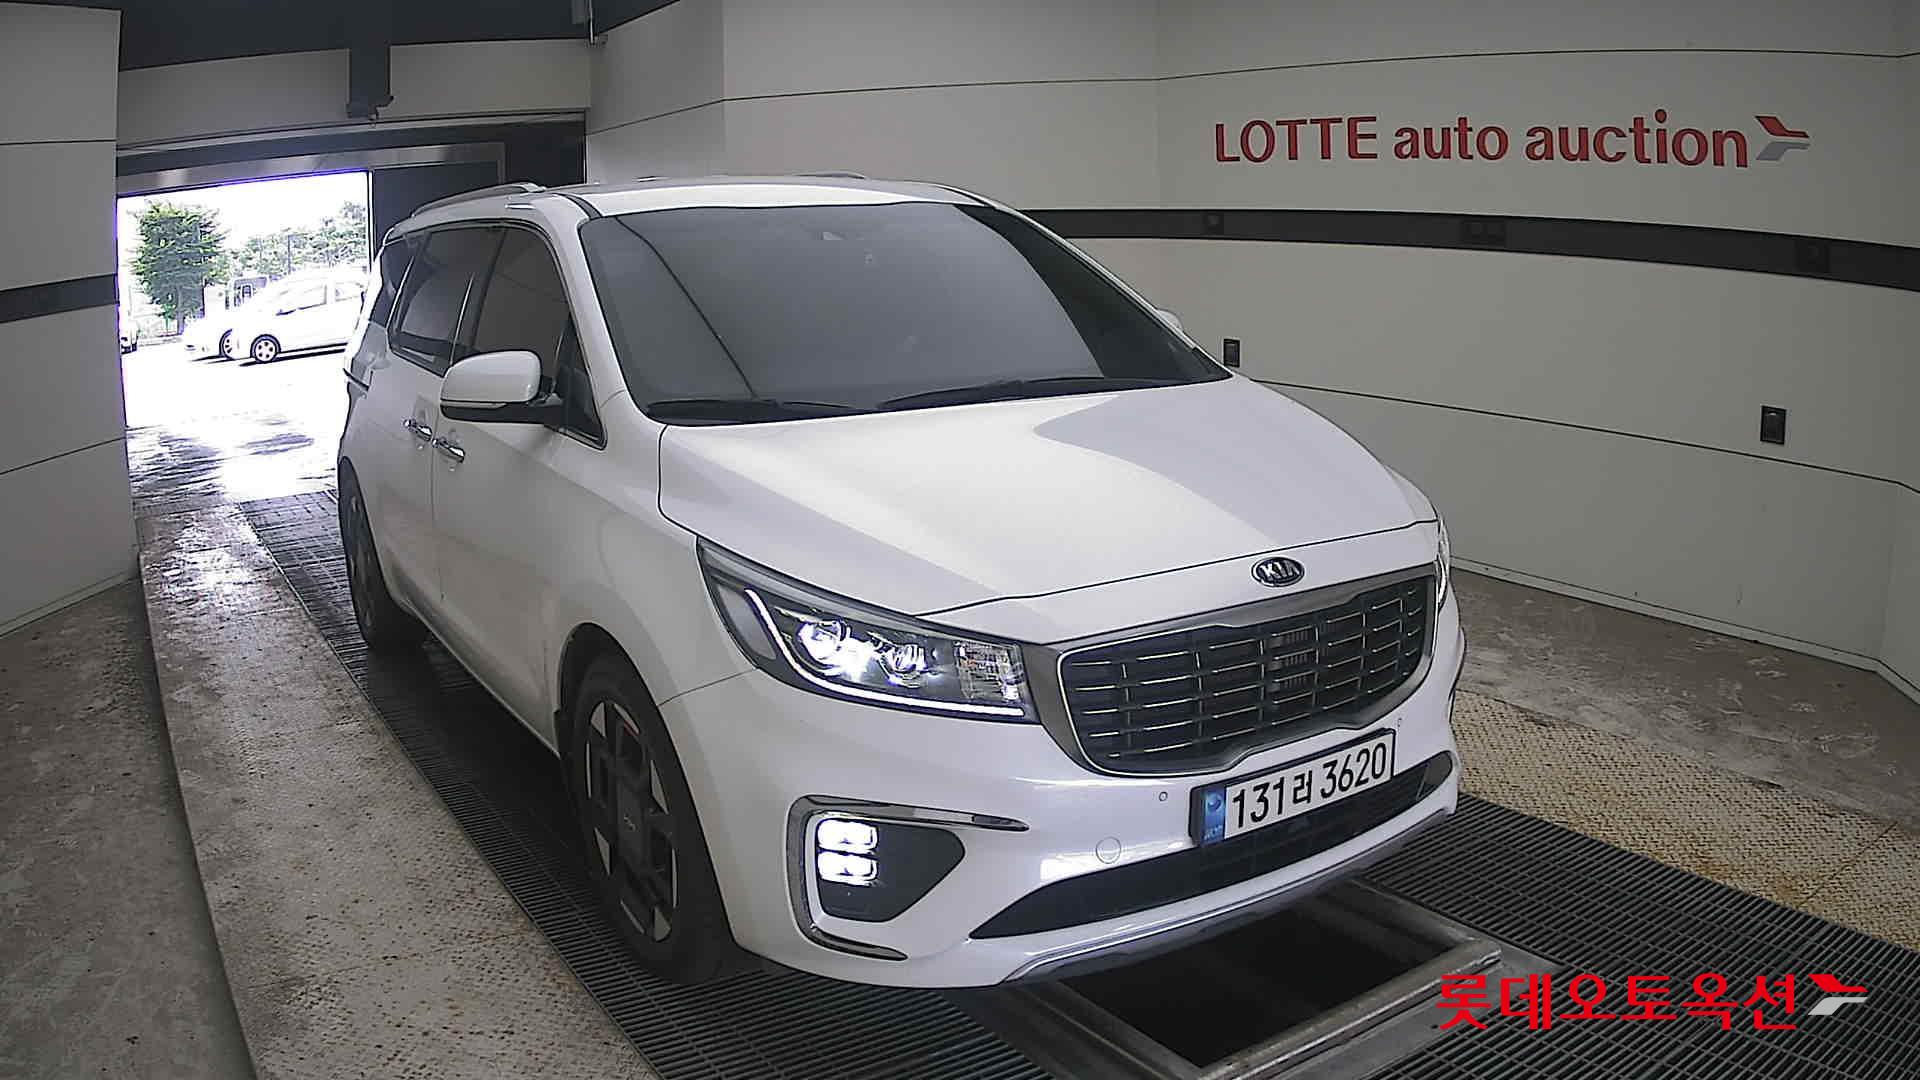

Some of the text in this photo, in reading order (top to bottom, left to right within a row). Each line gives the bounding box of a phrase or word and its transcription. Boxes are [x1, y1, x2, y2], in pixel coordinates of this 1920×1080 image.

[1215, 110, 1749, 168] LOTTE auto auction
[1320, 742, 1386, 799] 3620
